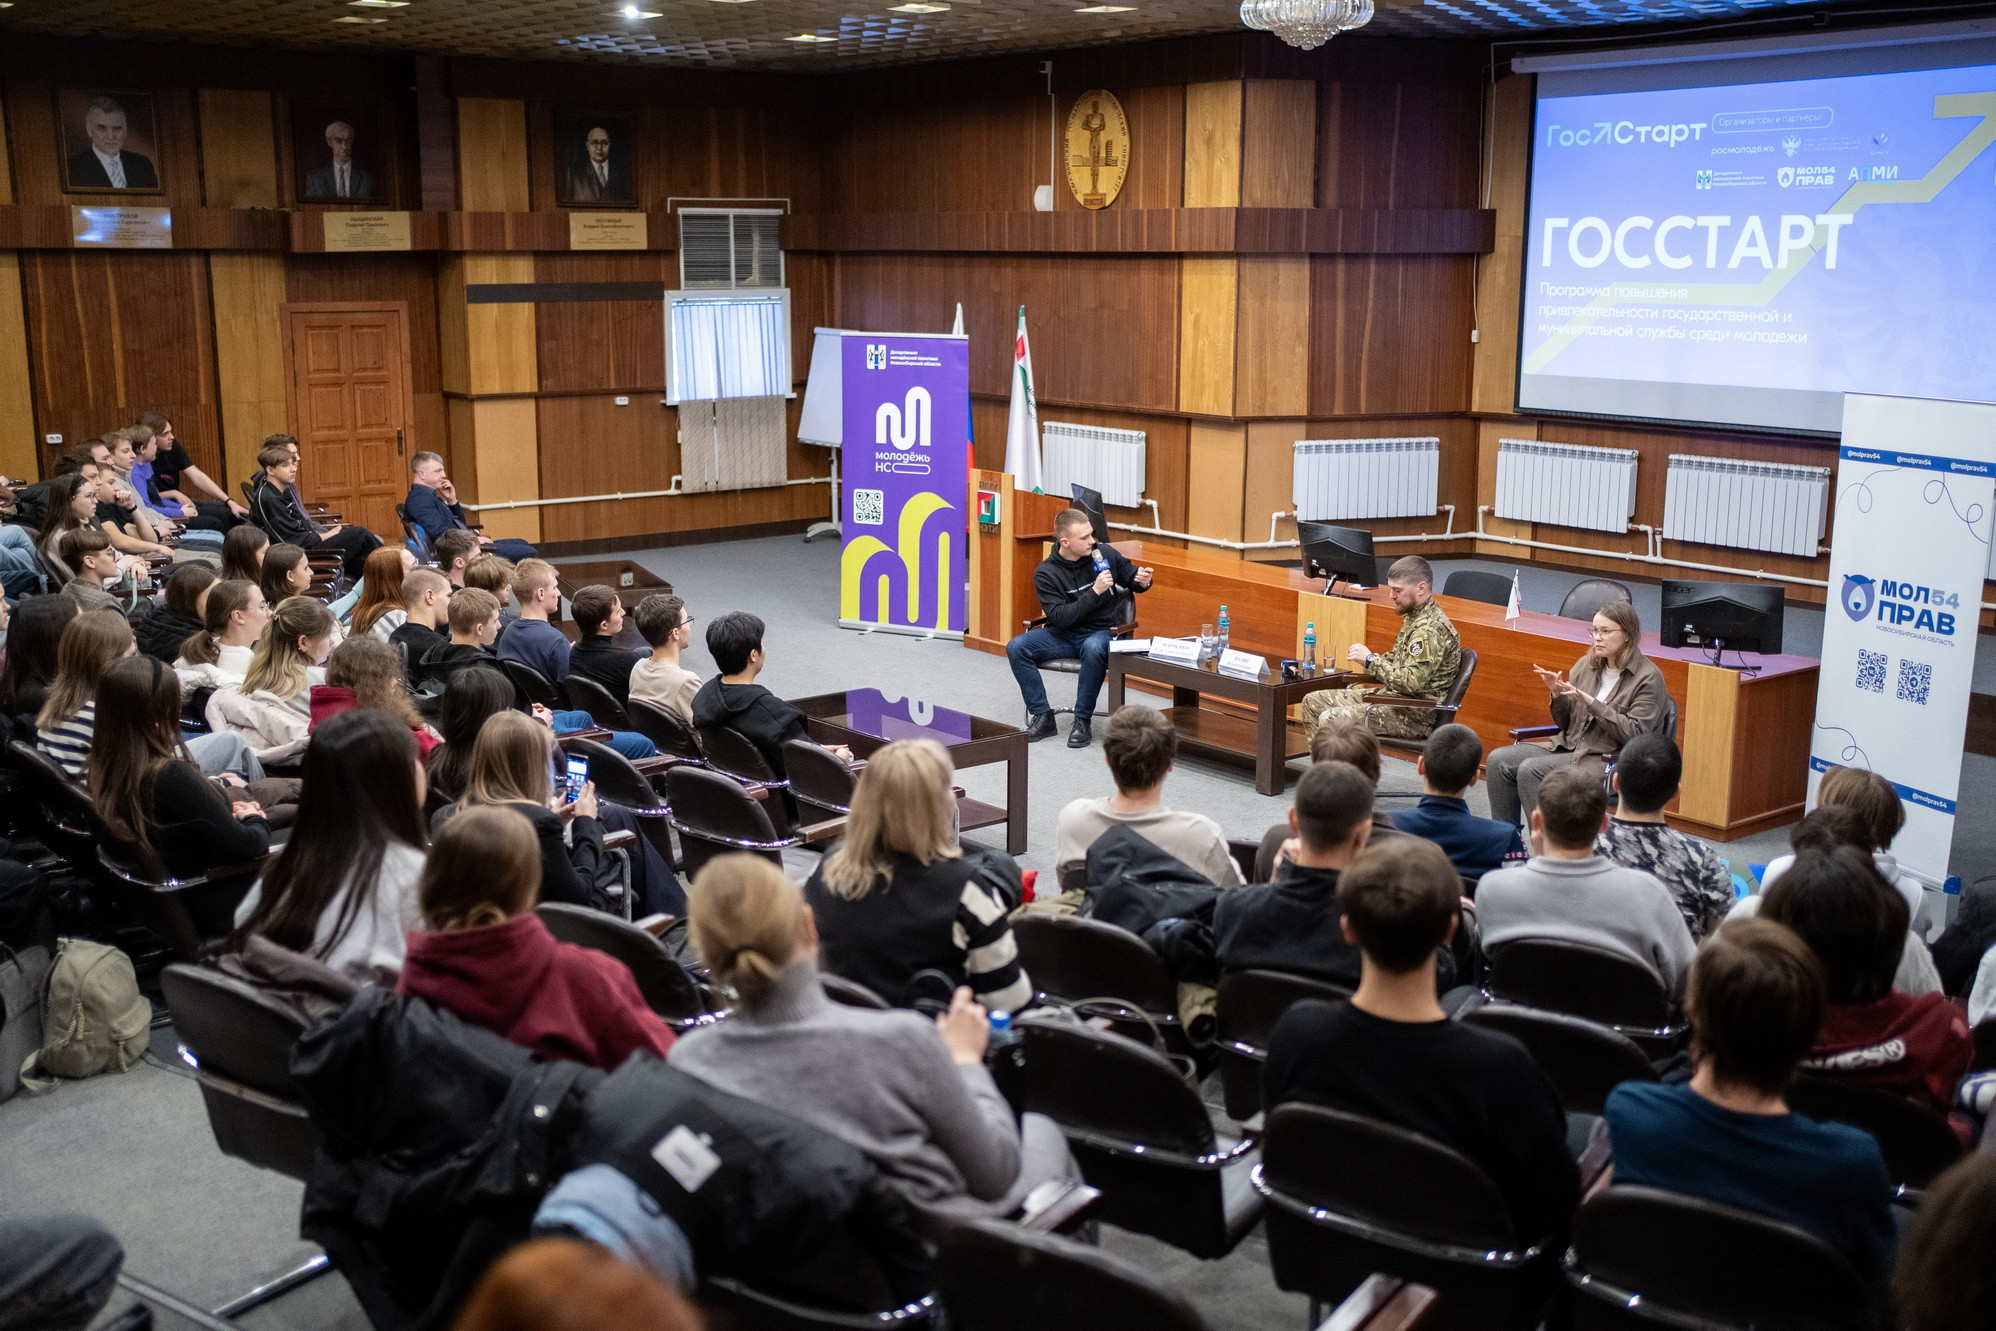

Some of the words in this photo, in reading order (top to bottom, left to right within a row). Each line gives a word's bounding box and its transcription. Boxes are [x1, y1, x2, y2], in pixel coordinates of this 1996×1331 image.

[1719, 117, 1773, 128] Организаторы
[1795, 175, 1834, 186] ПРАВ
[1542, 213, 1854, 270] ГОССТАРТ
[1540, 282, 1610, 299] Программа
[1615, 287, 1688, 298] повышения
[1539, 305, 1658, 319] привлекательности
[1663, 308, 1779, 323] государственной
[1783, 312, 1793, 322] и
[1538, 324, 1633, 337] муниципальной
[1637, 325, 1686, 340] службы
[1690, 329, 1730, 343] среди
[1734, 331, 1807, 344] молодежи
[876, 451, 930, 463] молодёжь
[1847, 450, 1881, 460] @molprav54
[1896, 456, 1932, 466] @molprav54
[1950, 462, 1988, 473] @molprav54
[1668, 585, 1695, 594] acer
[1880, 579, 1960, 609] МОЛ54
[1878, 600, 1956, 636] ПРАВ
[1876, 625, 1927, 641] НОВОСИБИРСКАЯ
[1926, 636, 1955, 648] ОБЛАСТЬ
[1912, 792, 1948, 809] @molprav54
